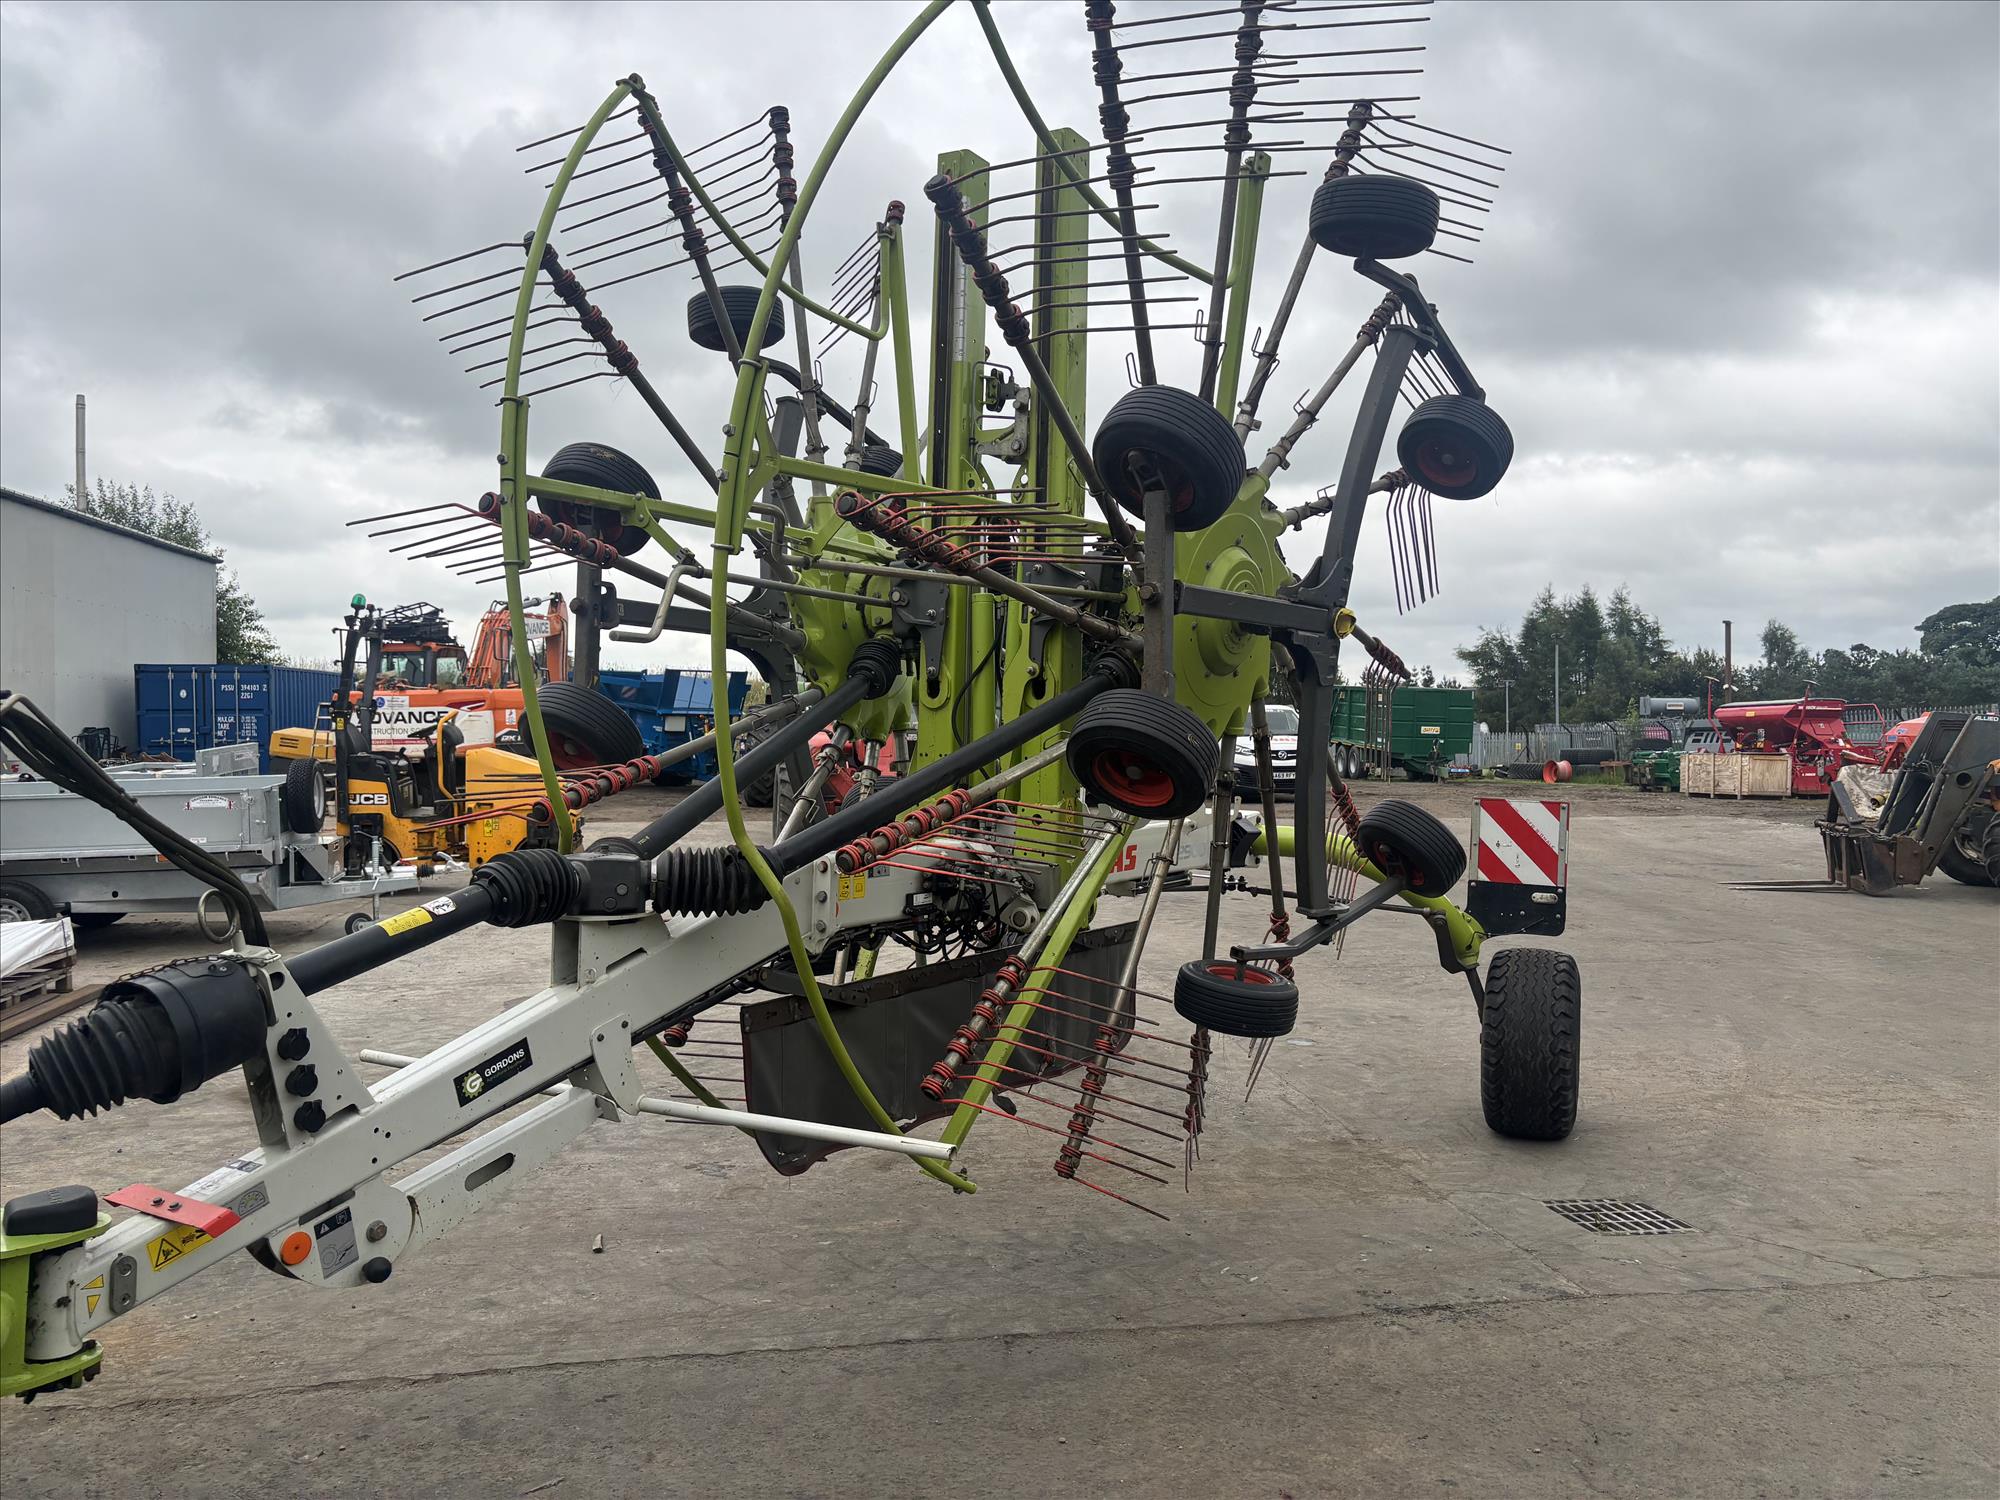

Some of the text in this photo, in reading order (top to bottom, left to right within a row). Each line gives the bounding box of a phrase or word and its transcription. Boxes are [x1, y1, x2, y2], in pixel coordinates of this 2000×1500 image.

[371, 711, 449, 724] DVANCE
[349, 793, 388, 805] JCB
[484, 1048, 525, 1078] GORDONS
